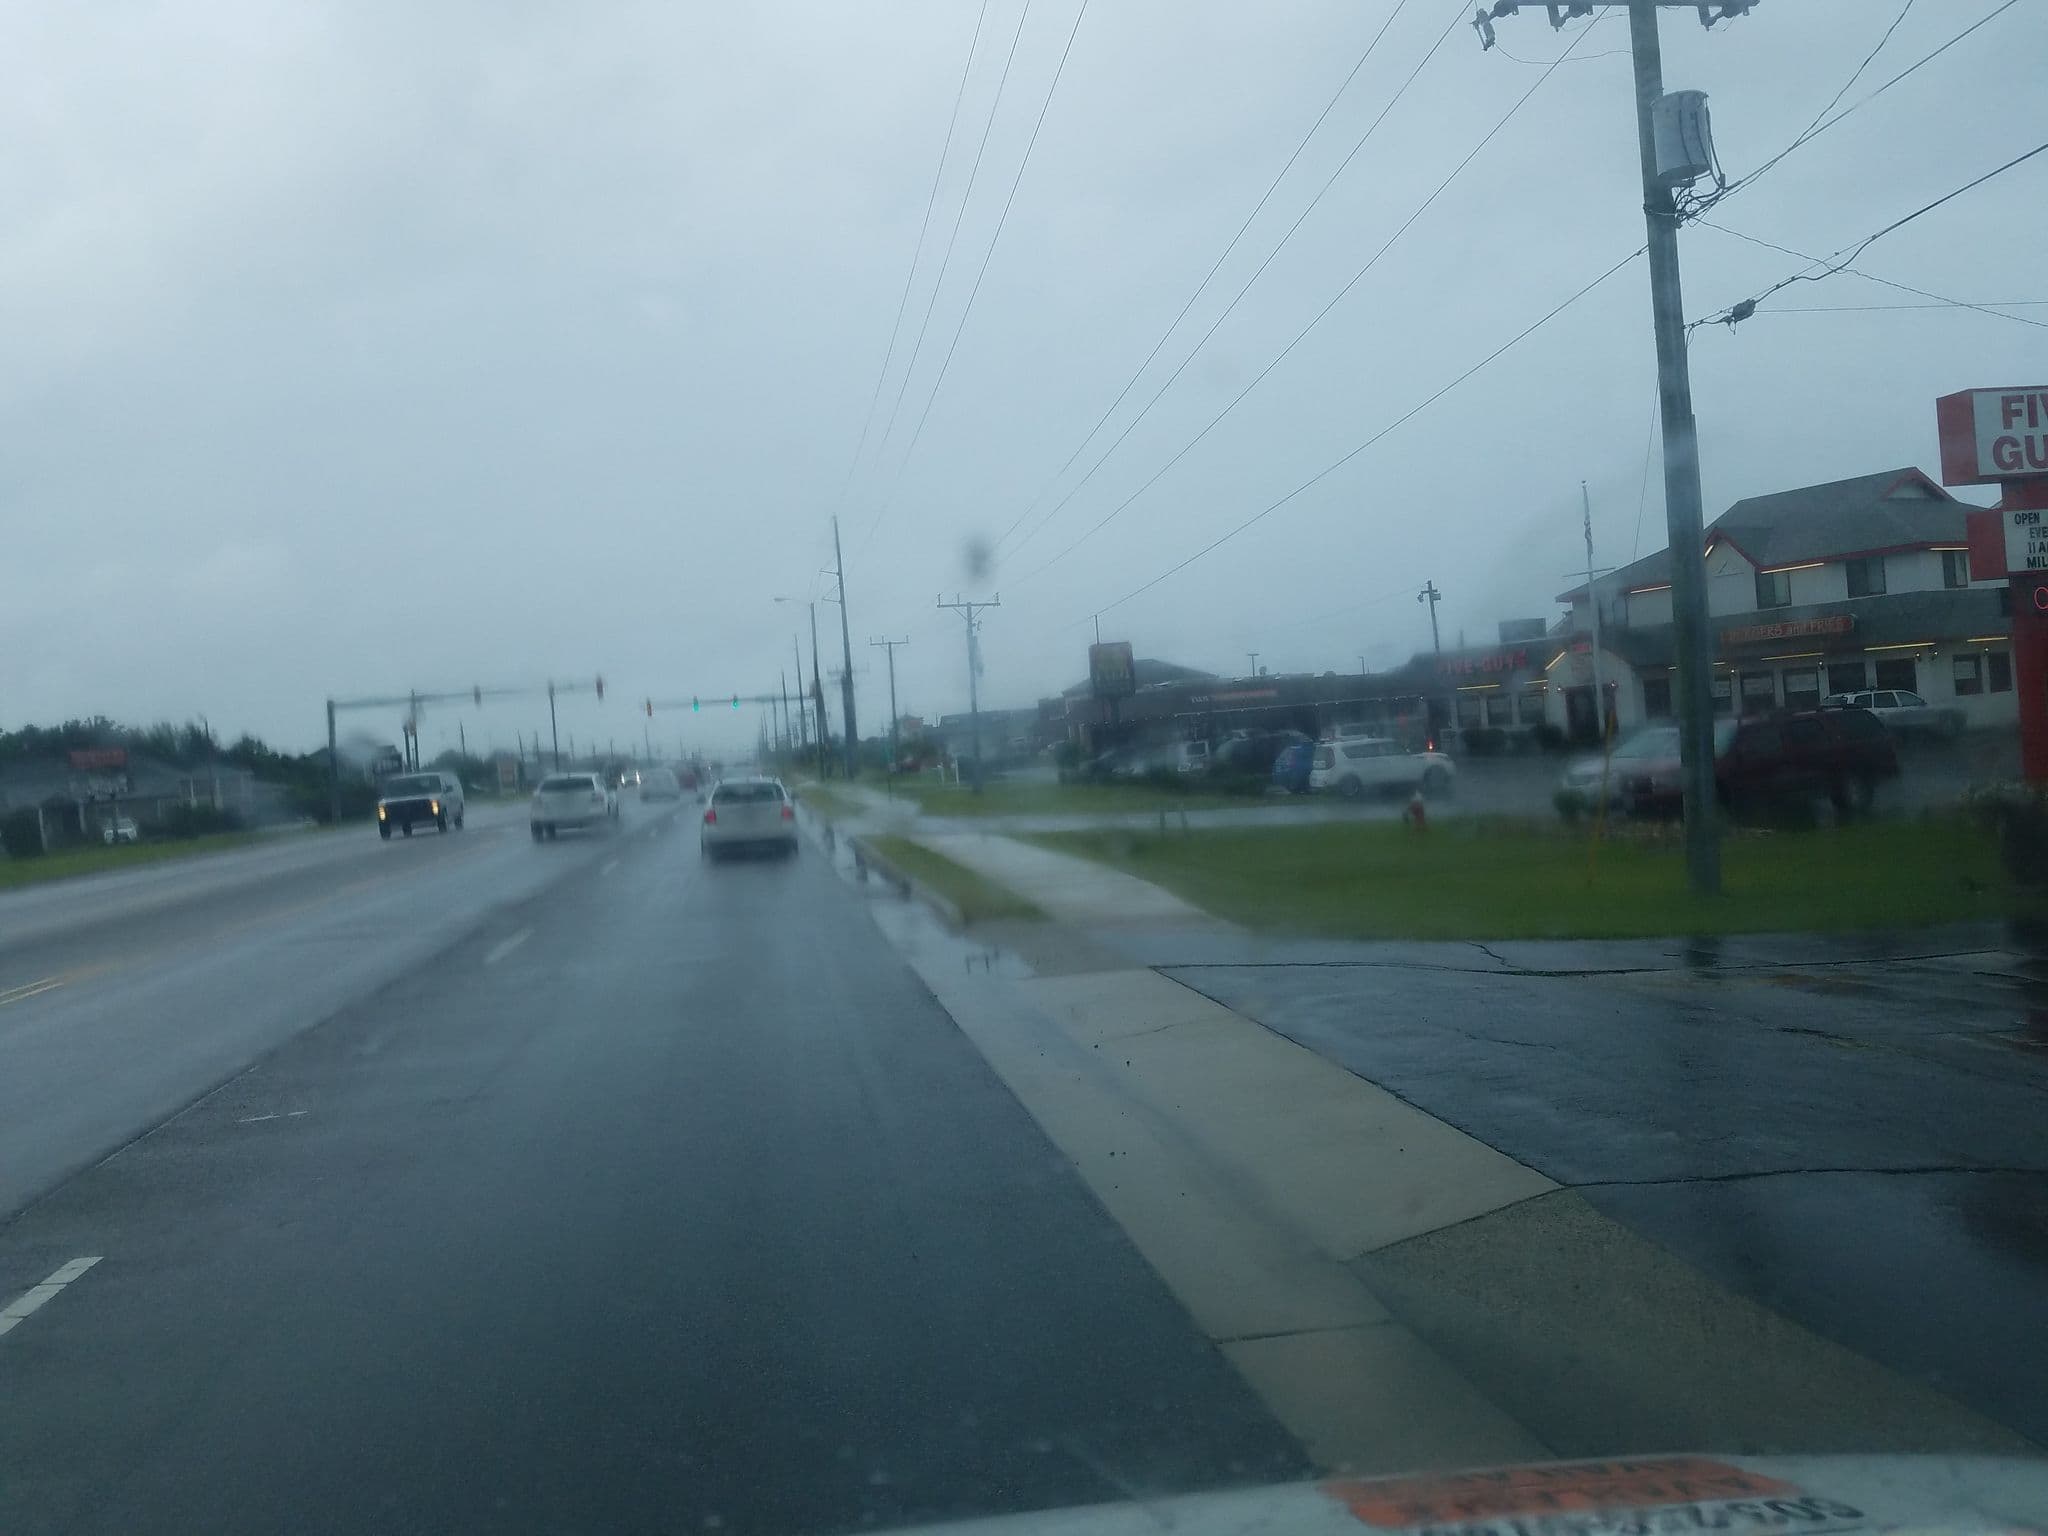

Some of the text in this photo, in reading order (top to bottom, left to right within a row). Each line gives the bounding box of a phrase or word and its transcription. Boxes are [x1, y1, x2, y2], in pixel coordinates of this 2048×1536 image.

[2014, 512, 2040, 525] OPEN
[2038, 541, 2048, 553] A
[1720, 625, 1784, 642] URGERS
[1436, 655, 1473, 675] IVE
